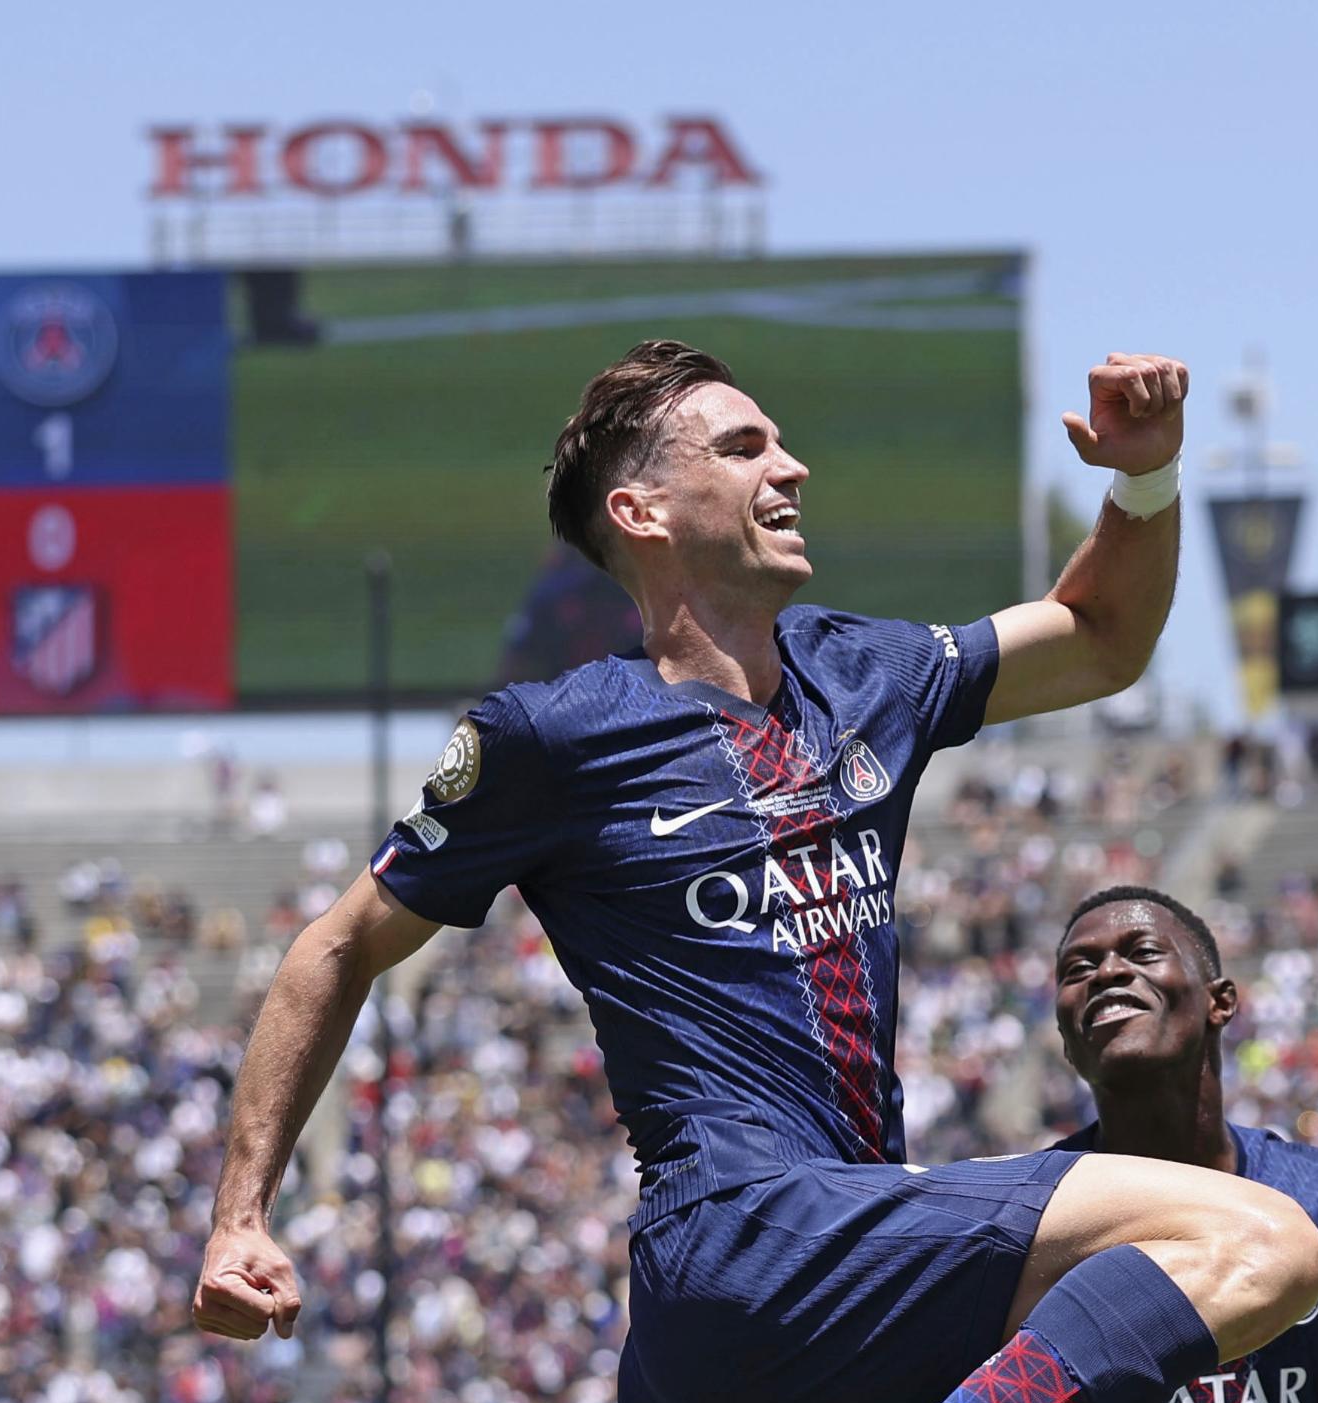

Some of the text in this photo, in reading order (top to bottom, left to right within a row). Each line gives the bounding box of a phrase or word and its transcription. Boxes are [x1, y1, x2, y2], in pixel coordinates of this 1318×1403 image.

[150, 114, 764, 197] HONDA
[33, 412, 73, 480] 1
[27, 504, 77, 571] 0
[686, 828, 887, 934] QATAR
[772, 889, 890, 952] AIRWAYS
